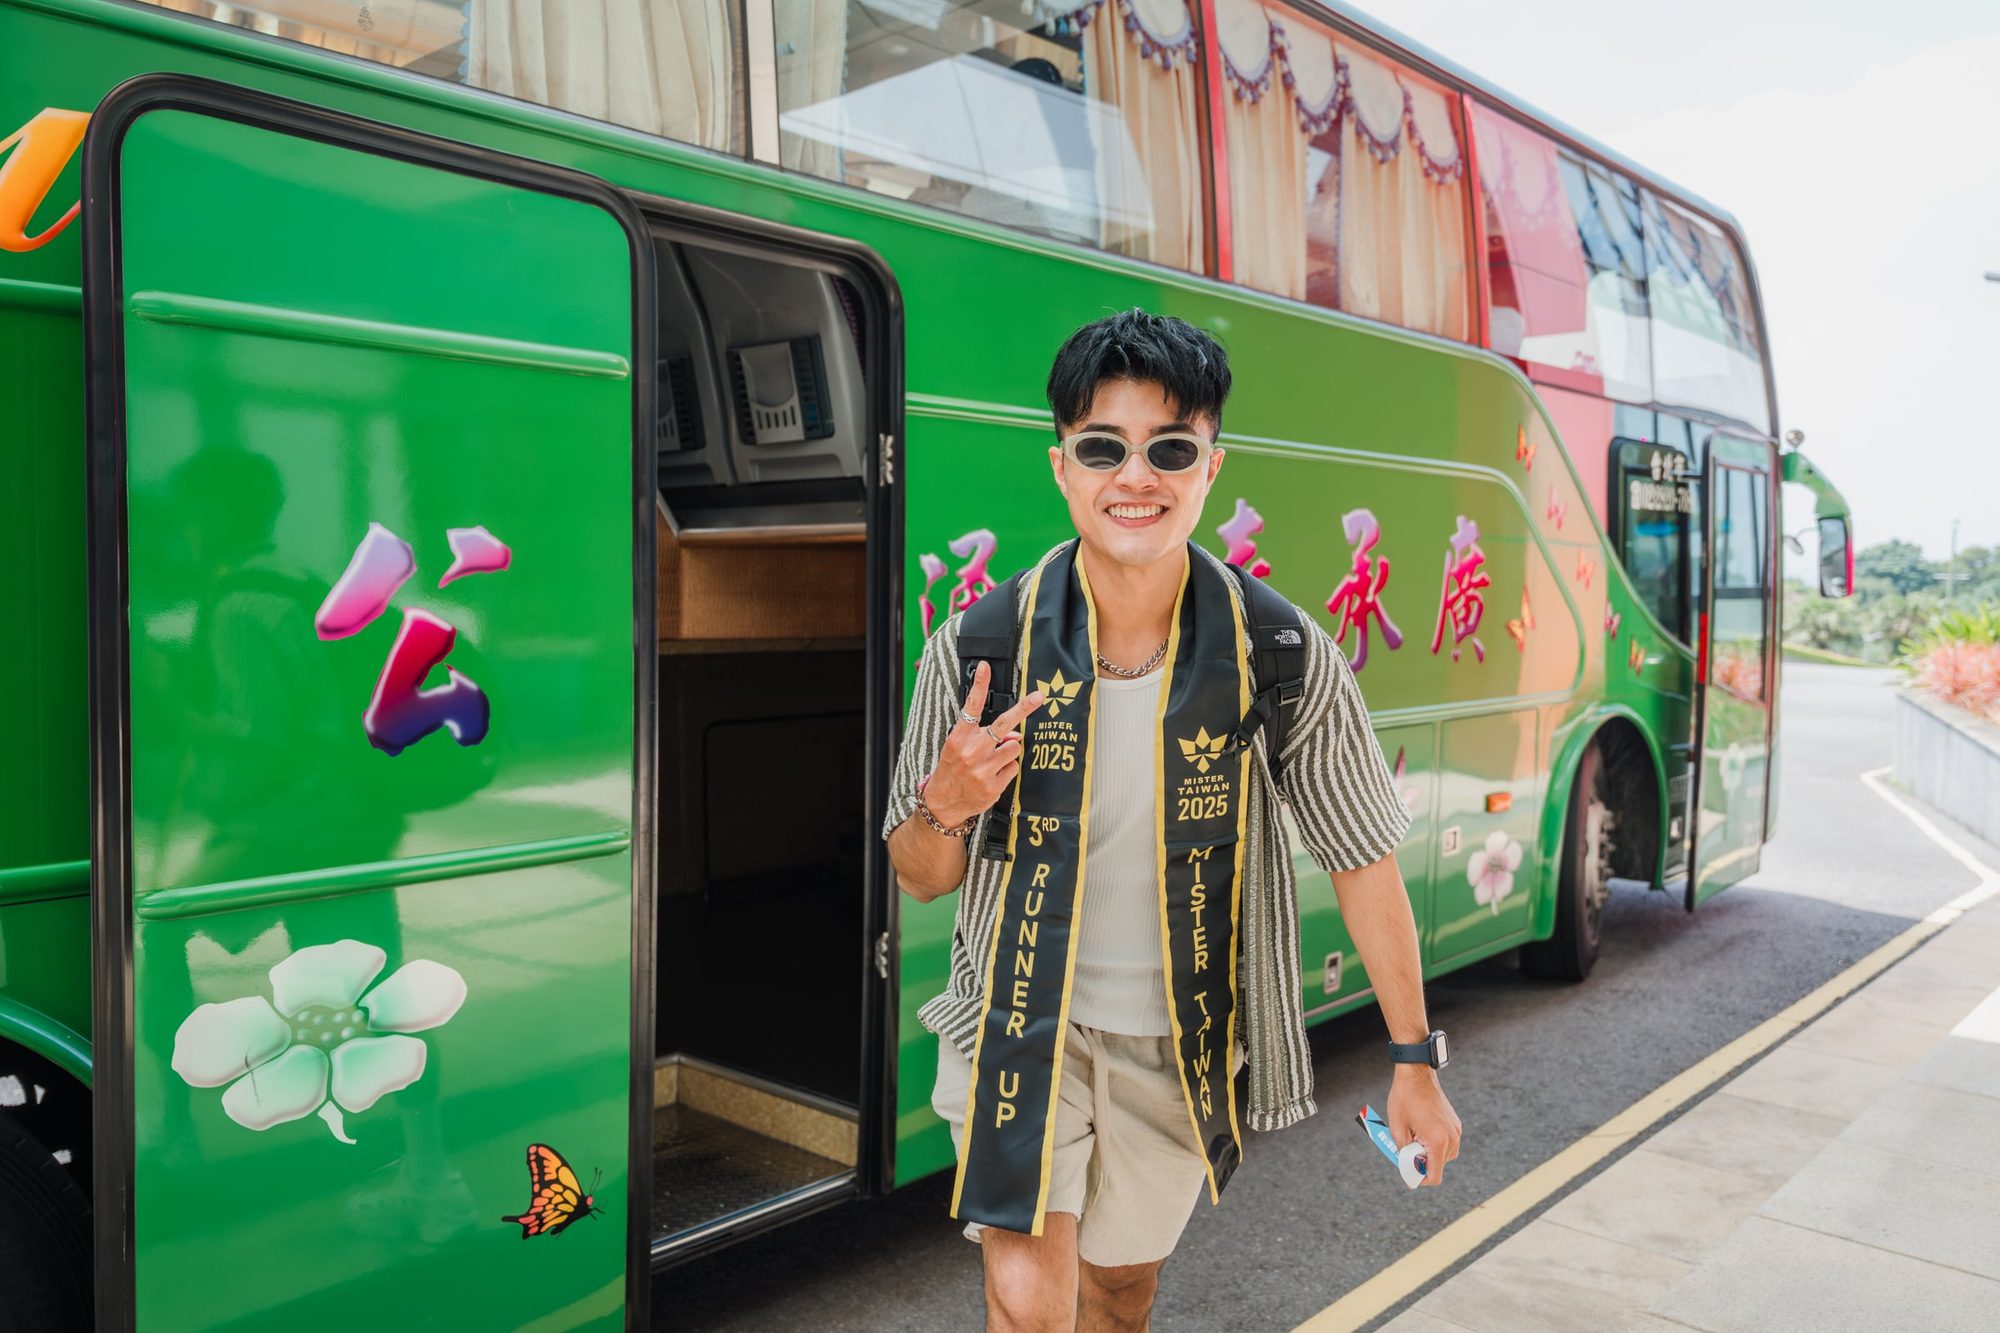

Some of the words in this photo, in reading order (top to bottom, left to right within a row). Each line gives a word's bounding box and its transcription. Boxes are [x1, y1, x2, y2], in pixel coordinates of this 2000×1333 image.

[315, 517, 512, 757] 公
[1033, 731, 1078, 742] TAIWAN
[1038, 721, 1073, 731] MISTER
[1030, 743, 1076, 772] 2025
[1177, 782, 1230, 795] TAIWAN
[1183, 774, 1225, 785] MISTER
[1177, 794, 1228, 821] 2025
[1027, 815, 1060, 847] 3RD
[1187, 846, 1214, 974] MISTER
[1005, 863, 1050, 1038] RUNNER
[1193, 991, 1213, 1122] TAIWAN
[995, 1070, 1020, 1128] UP
